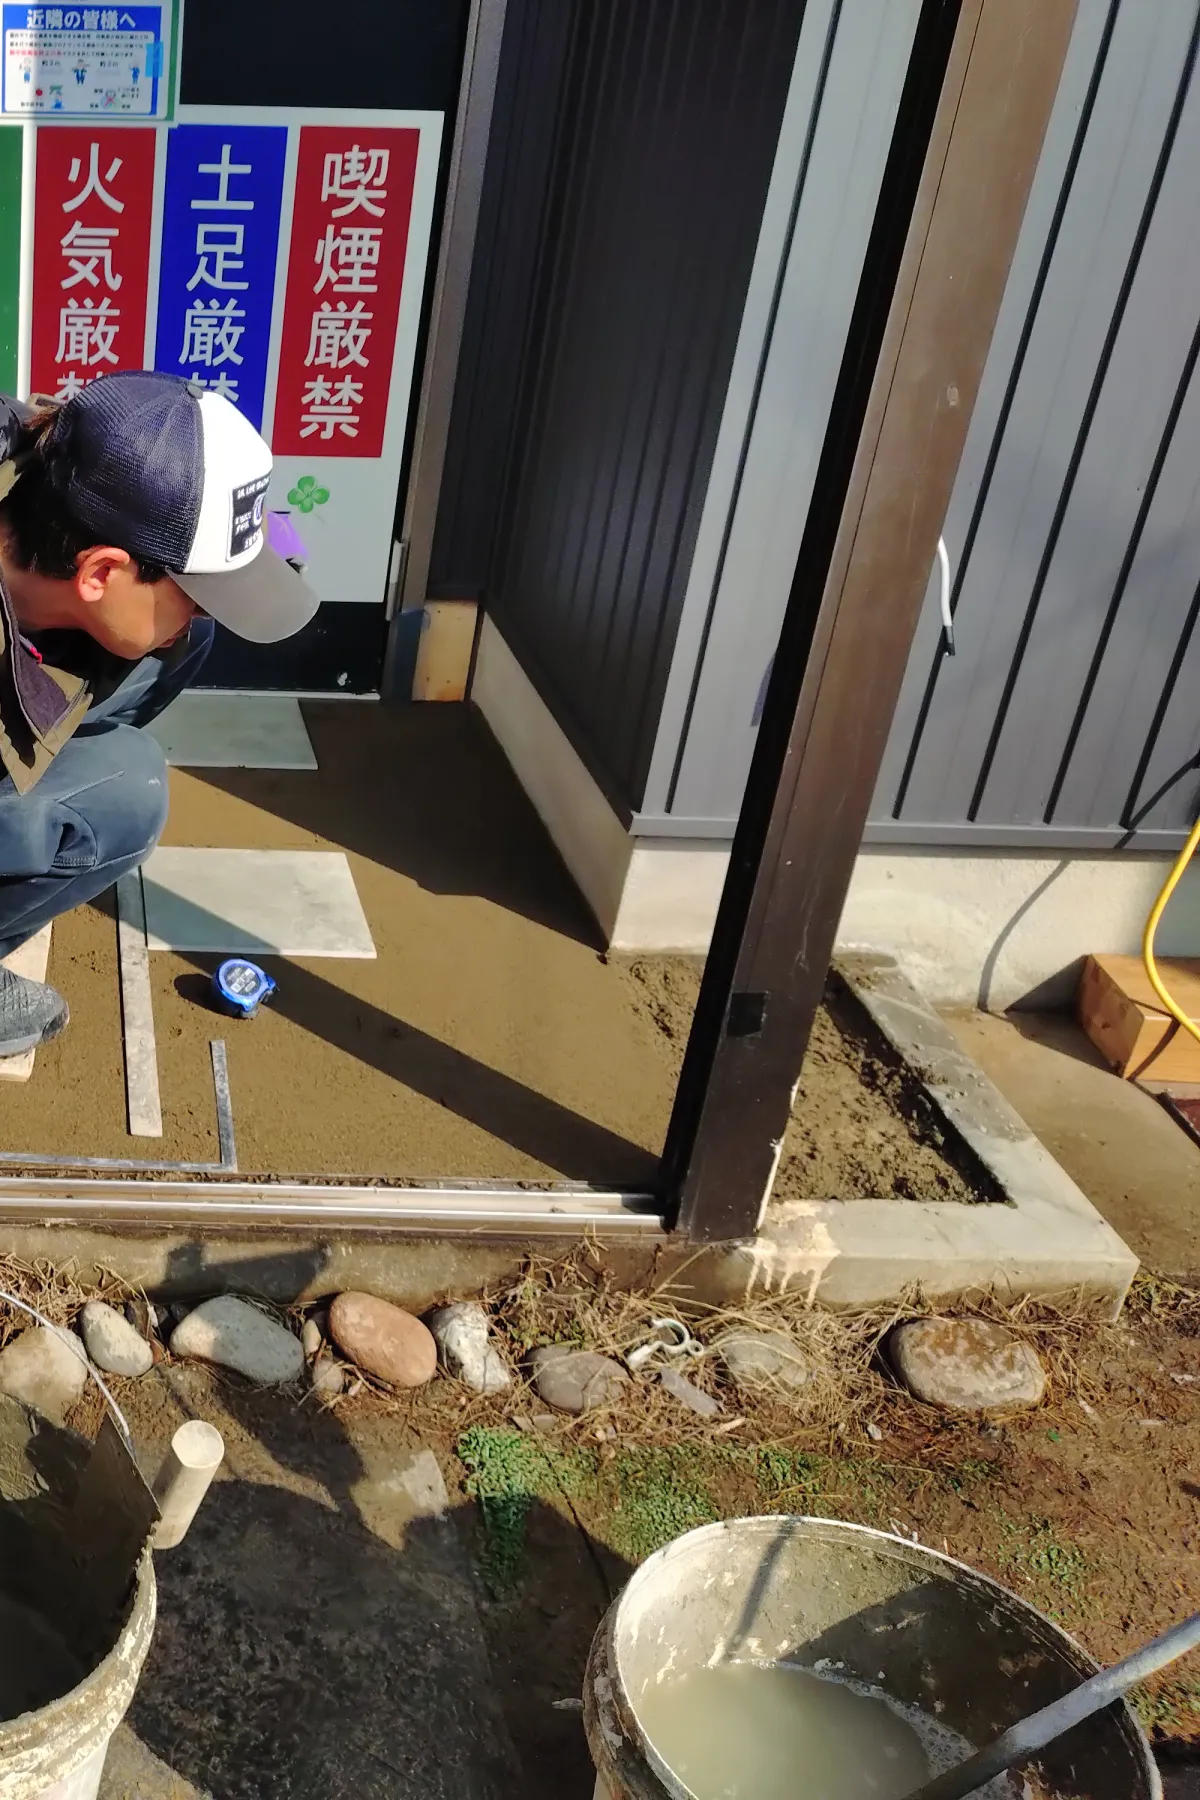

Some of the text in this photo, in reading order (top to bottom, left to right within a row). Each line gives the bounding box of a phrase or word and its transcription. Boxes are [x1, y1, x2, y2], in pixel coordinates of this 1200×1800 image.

[26, 8, 136, 30] 近隣の皆様へ
[299, 144, 390, 441] 喫煙厳禁
